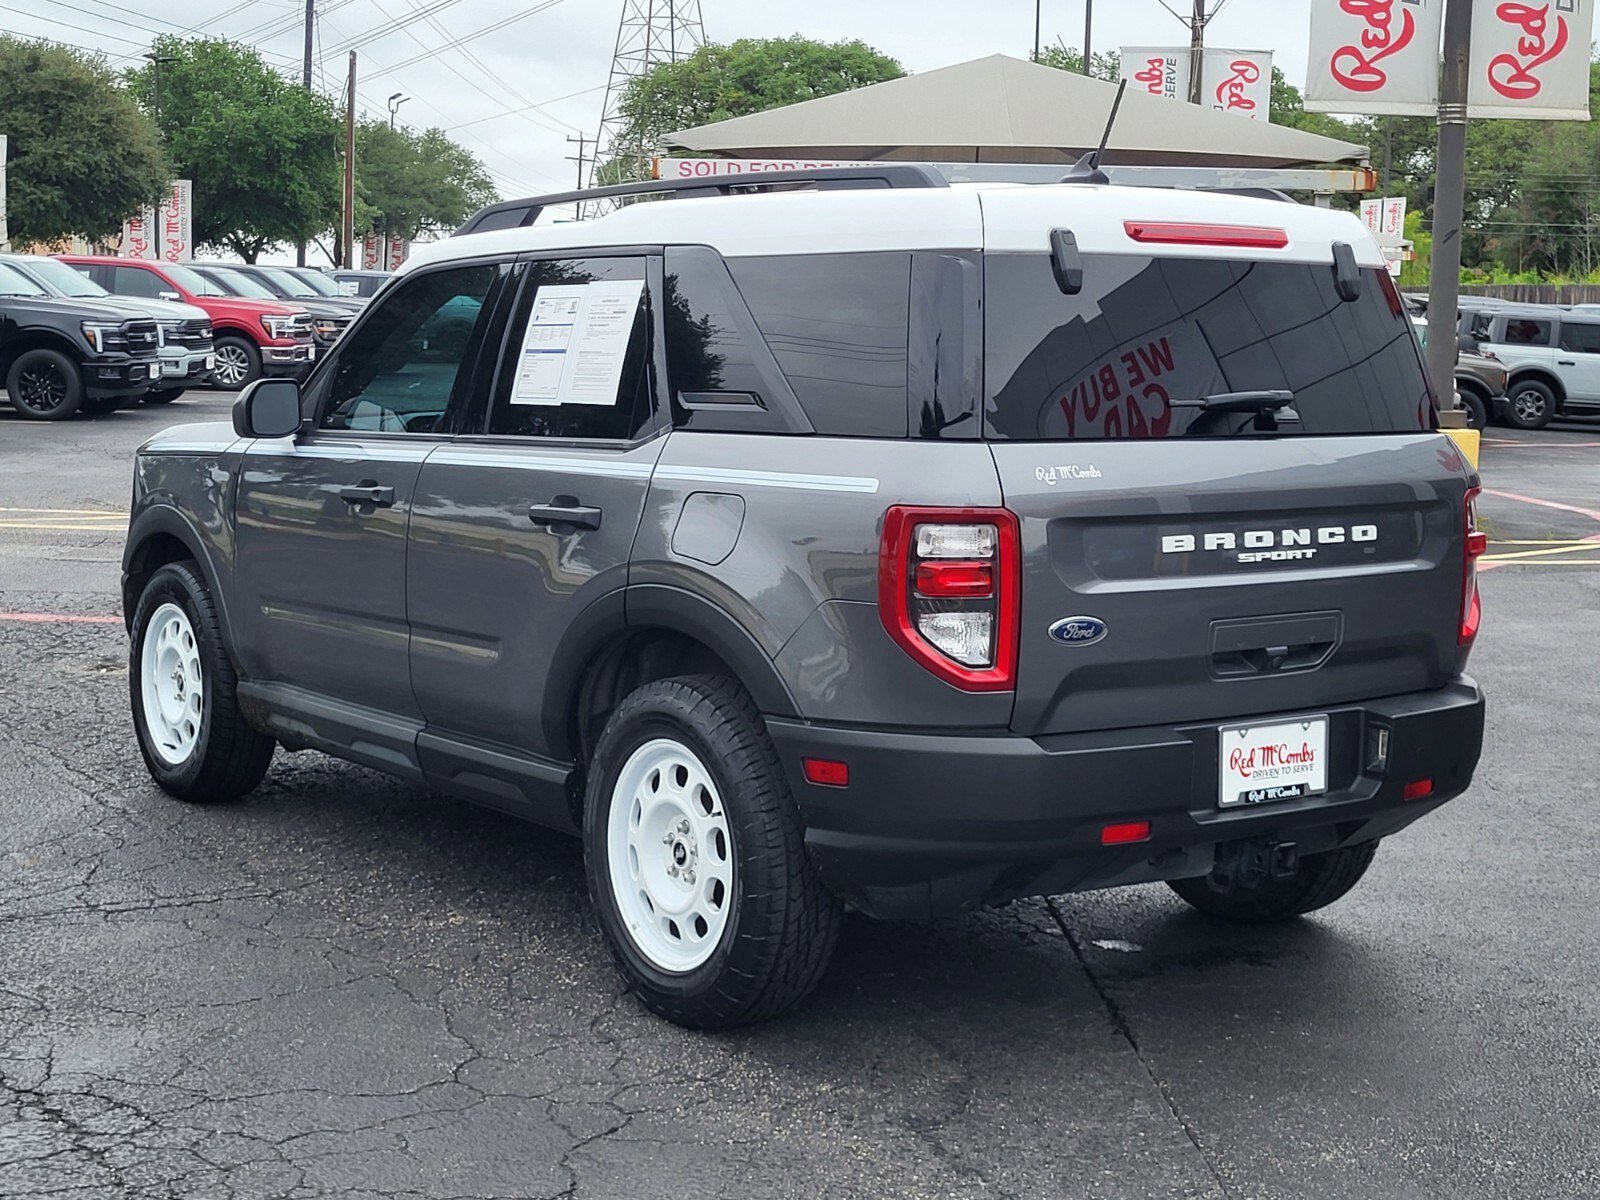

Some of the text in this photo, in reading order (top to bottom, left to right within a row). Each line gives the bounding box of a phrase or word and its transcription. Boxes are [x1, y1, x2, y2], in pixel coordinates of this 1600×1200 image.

[1330, 0, 1416, 92] Red
[1487, 2, 1569, 100] Red
[1216, 60, 1260, 110] Red
[1035, 466, 1057, 485] Red
[1161, 524, 1378, 553] BRONCO
[1237, 548, 1318, 563] SPORT
[1230, 742, 1315, 778] Red McCombs
[1252, 763, 1315, 779] DRIVEN TO SERVE
